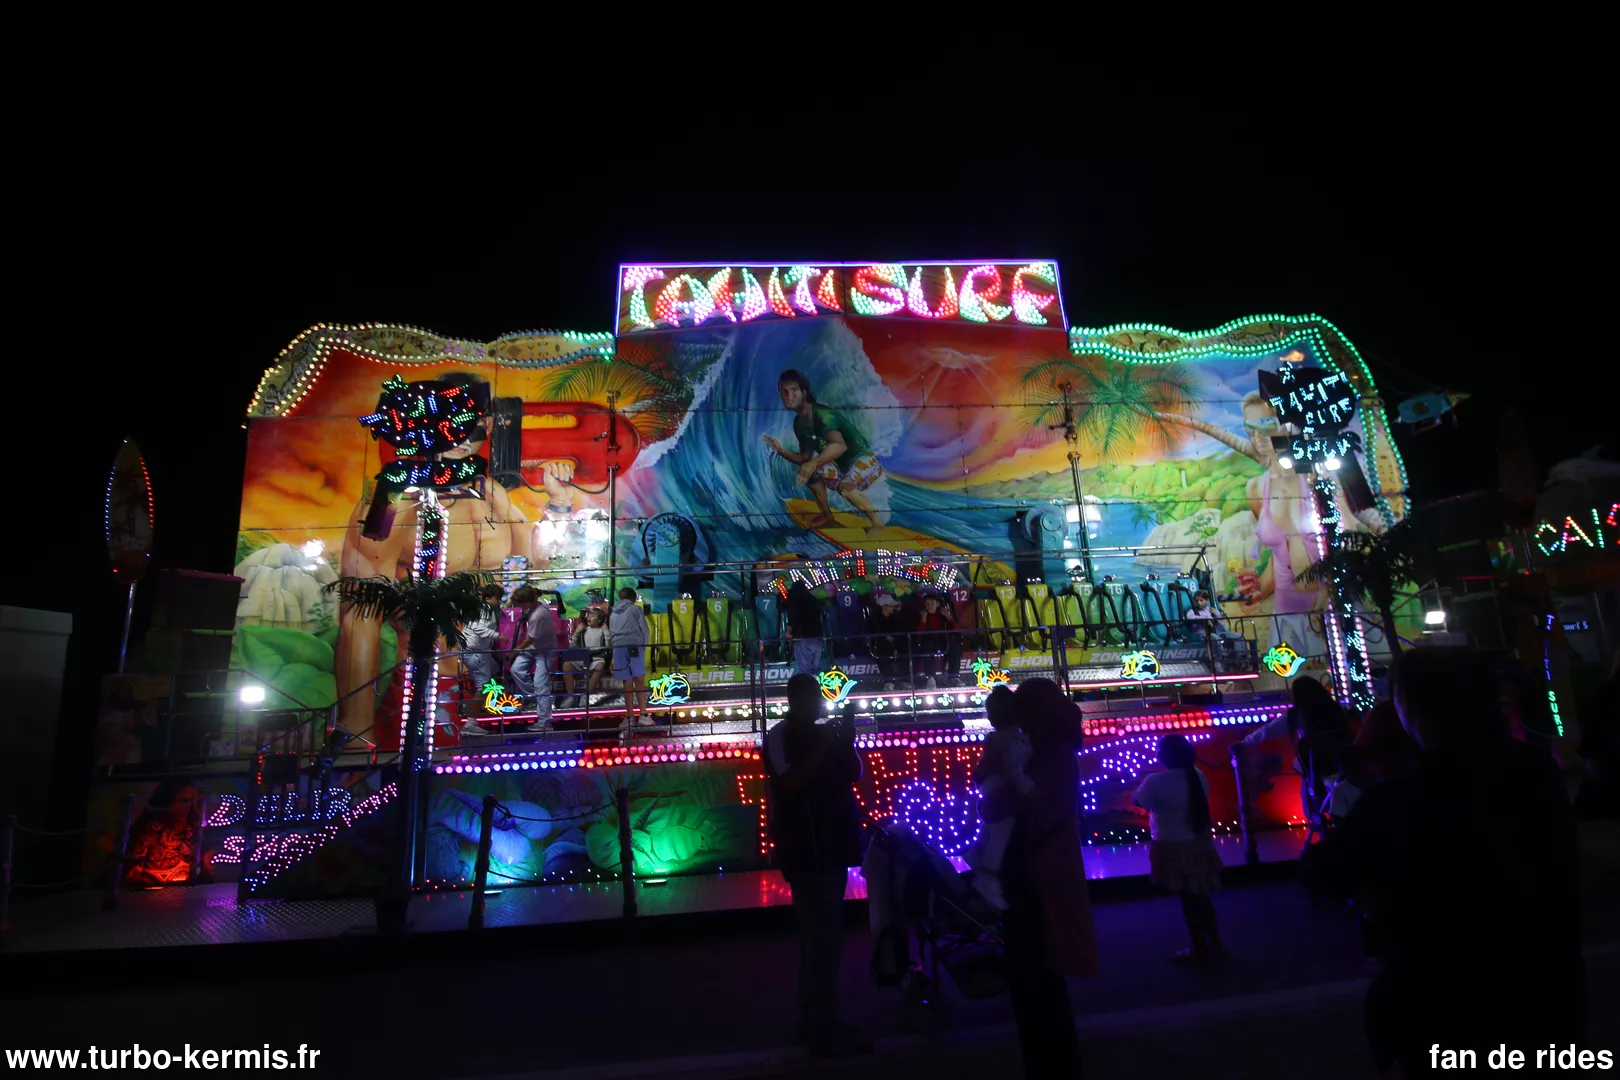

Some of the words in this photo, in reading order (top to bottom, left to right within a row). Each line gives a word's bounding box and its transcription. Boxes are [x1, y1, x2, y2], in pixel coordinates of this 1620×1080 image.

[623, 265, 841, 328] TAHITI
[850, 261, 1056, 325] SURF
[953, 590, 968, 602] 12
[1000, 588, 1014, 599] 13
[1031, 587, 1045, 599] 14
[1078, 584, 1091, 596] 15
[1109, 584, 1123, 596] 16
[713, 600, 722, 613] 6
[762, 599, 771, 611] 7
[843, 595, 852, 607] 9
[679, 602, 688, 614] 5
[507, 611, 515, 622] 1
[687, 670, 735, 682] ELIRE
[743, 668, 795, 681] SHOW
[1547, 690, 1564, 738] SURF
